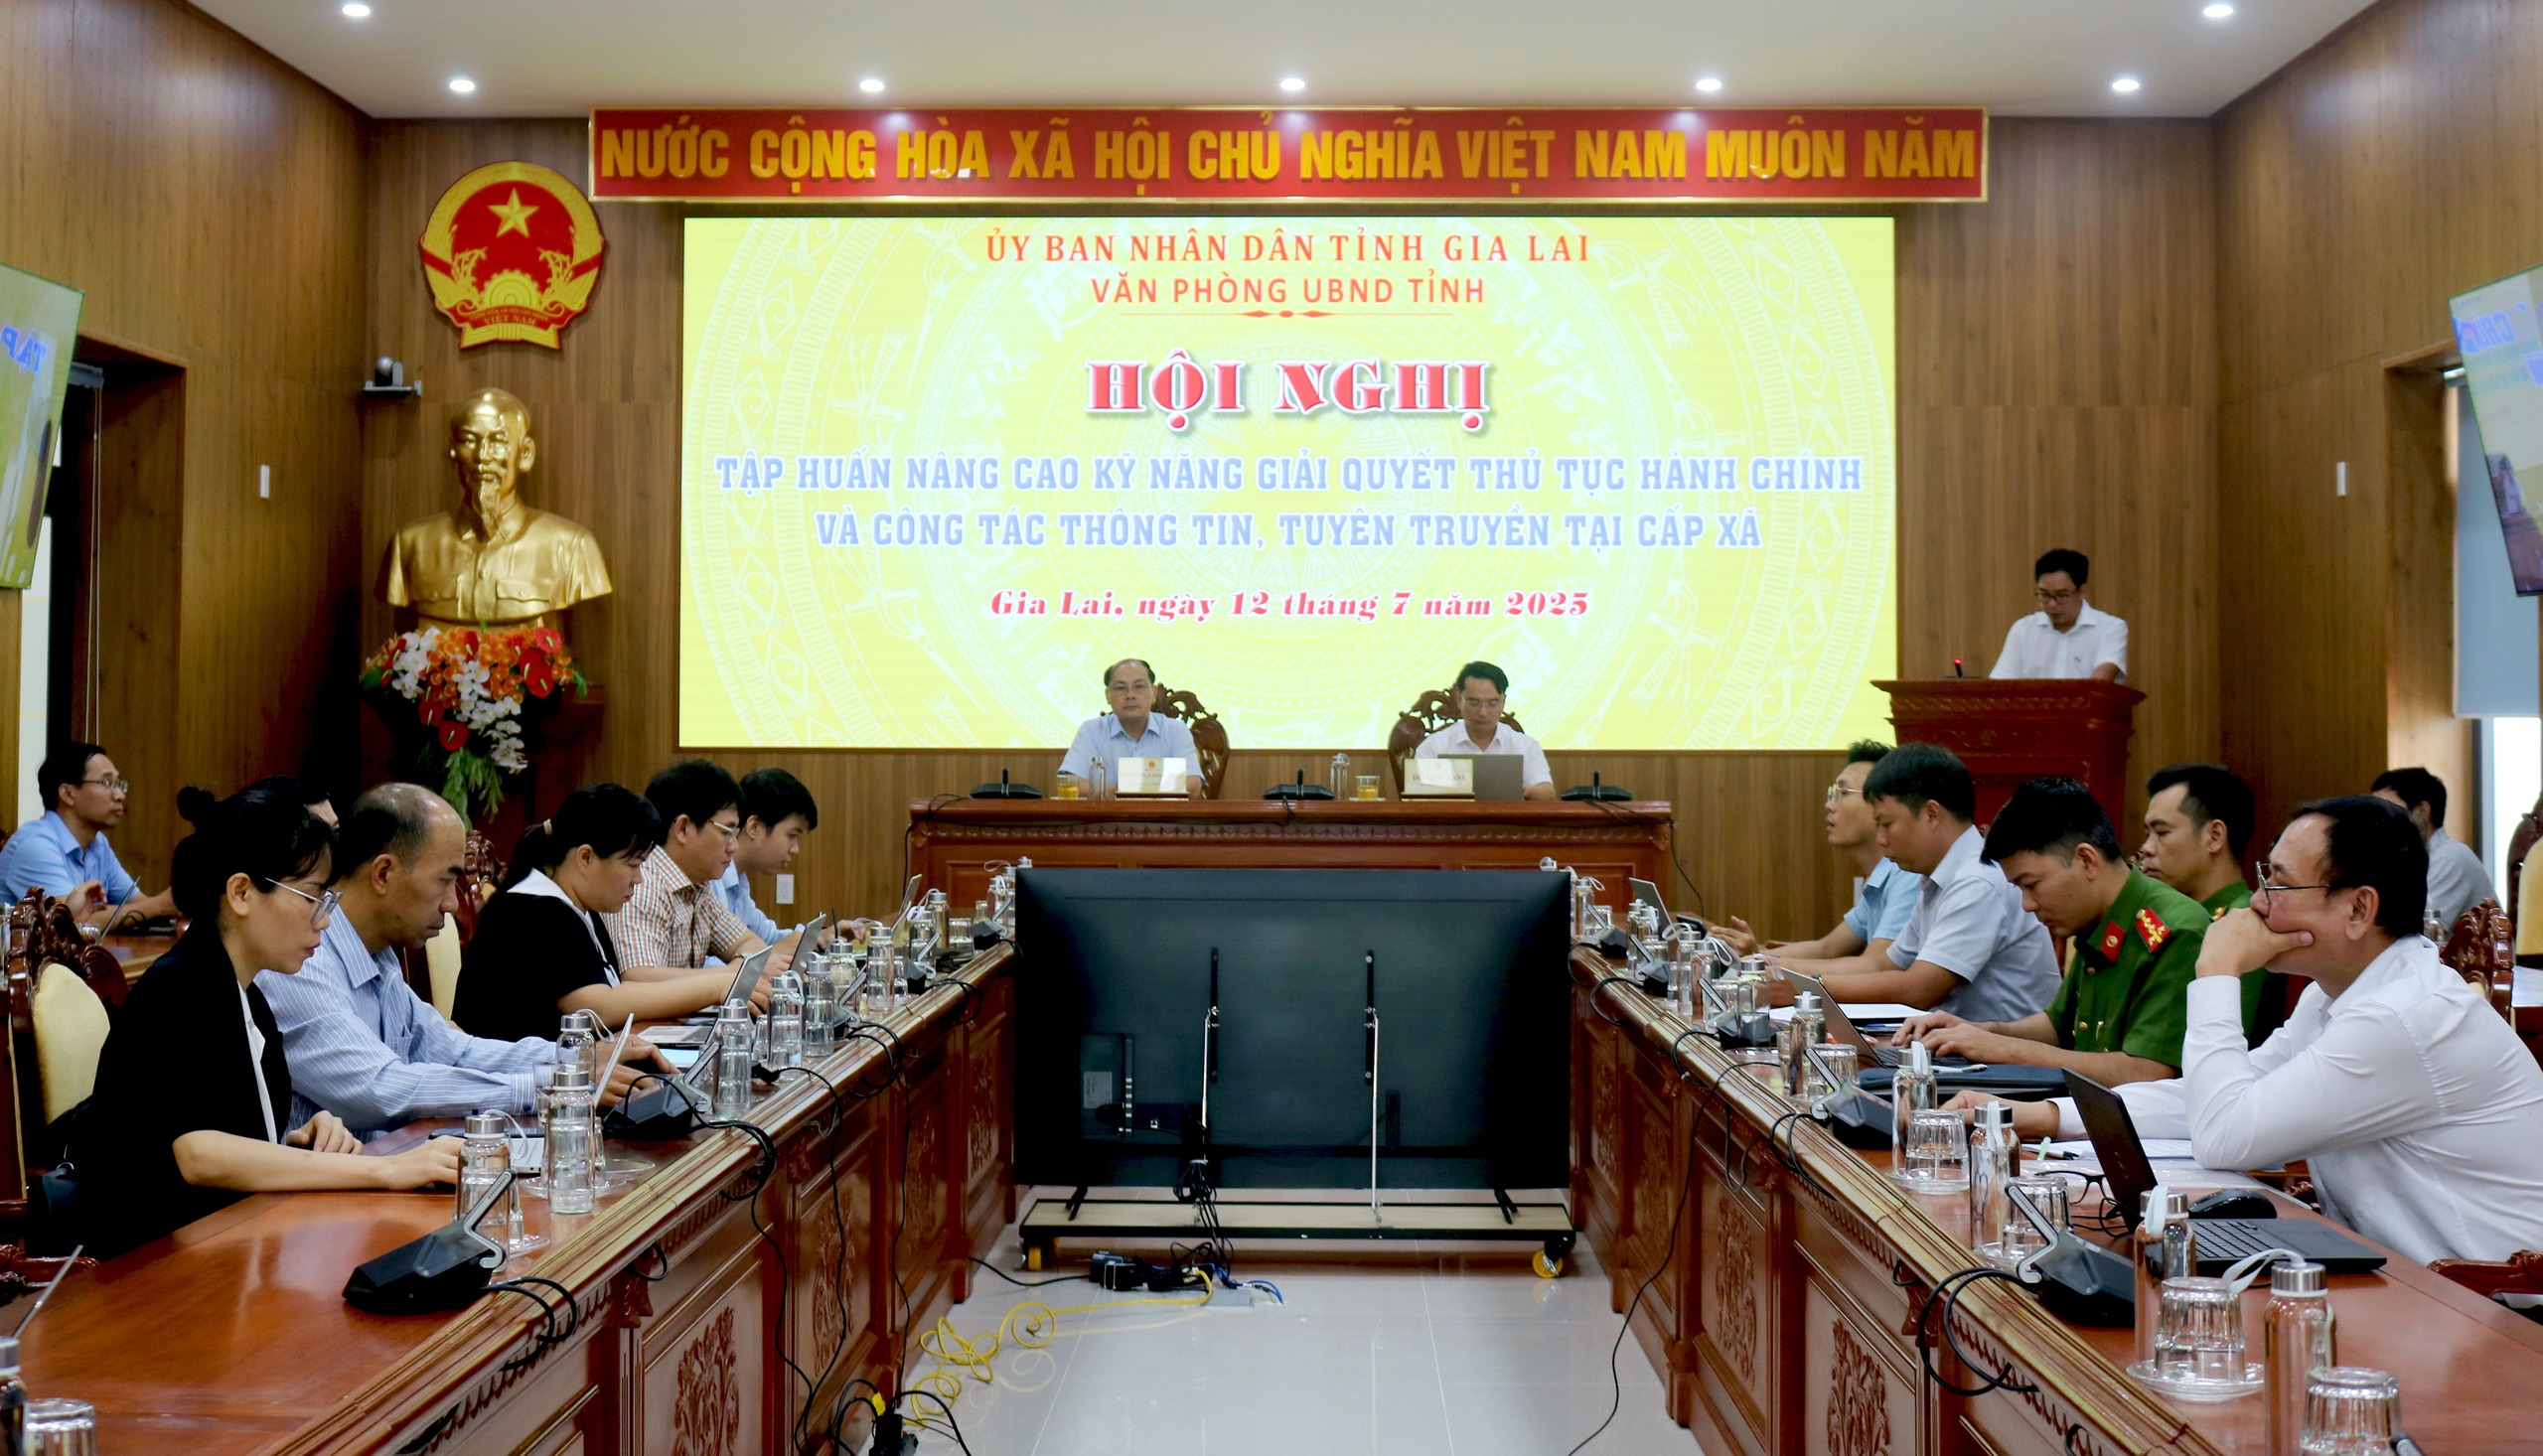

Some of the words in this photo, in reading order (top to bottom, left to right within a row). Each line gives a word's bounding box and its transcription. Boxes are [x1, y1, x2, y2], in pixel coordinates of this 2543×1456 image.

[600, 115, 730, 179] NƯỚC
[750, 115, 876, 195] CỘNG
[896, 116, 989, 180] HÒA
[1009, 117, 1074, 180] XÃ
[1095, 116, 1170, 196] HỘI
[1190, 110, 1280, 181] CHỦ
[1299, 116, 1443, 180] NGHĨA
[1456, 116, 1556, 195] VIỆT
[1574, 129, 1686, 180] NAM
[1706, 115, 1846, 180] MUÔN
[1864, 115, 1975, 180] NĂM
[986, 227, 1030, 262] ỦY
[1044, 234, 1116, 262] BAN
[1129, 227, 1232, 262] NHÂN
[1243, 227, 1318, 262] DÂN
[1329, 226, 1424, 262] TỈNH
[1443, 234, 1509, 262] GIA
[1528, 234, 1590, 262] LAI
[1091, 272, 1158, 304] VĂN
[1172, 272, 1288, 304] PHÒNG
[1302, 277, 1394, 304] UBND
[1408, 268, 1485, 304] TỈNH
[1085, 348, 1246, 431] HỘI
[1272, 356, 1492, 431] NGHỊ
[714, 449, 785, 497] TẬP
[797, 446, 893, 491] HUẤN
[906, 449, 1000, 491] NÂNG
[1011, 456, 1081, 491] CAO
[1093, 451, 1136, 491] KỸ
[1149, 451, 1243, 491] NĂNG
[1256, 447, 1328, 491] GIẢI
[1341, 446, 1457, 493] QUYẾT
[1469, 447, 1543, 491] THỦ
[1556, 456, 1627, 498] TỤC
[1638, 449, 1737, 492] HÀNH
[1750, 449, 1864, 492] CHÍNH
[814, 505, 860, 547] VÀ
[872, 508, 966, 547] CÔNG
[976, 505, 1046, 547] TÁC
[1059, 508, 1179, 547] THÔNG
[1192, 511, 1267, 551] TIN,
[1277, 508, 1396, 547] TUYÊN
[1409, 503, 1551, 547] TRUYỀN
[1564, 511, 1624, 553] TẠI
[1636, 503, 1706, 547] CẤP
[1716, 508, 1763, 547] XÃ
[989, 589, 1048, 618] Gia
[1057, 589, 1124, 620] Lai,
[1135, 592, 1218, 624] ngày
[1228, 591, 1272, 618] 12
[1281, 590, 1379, 624] tháng
[1391, 591, 1413, 618] 7
[1421, 593, 1493, 618] năm
[1505, 591, 1589, 618] 2025
